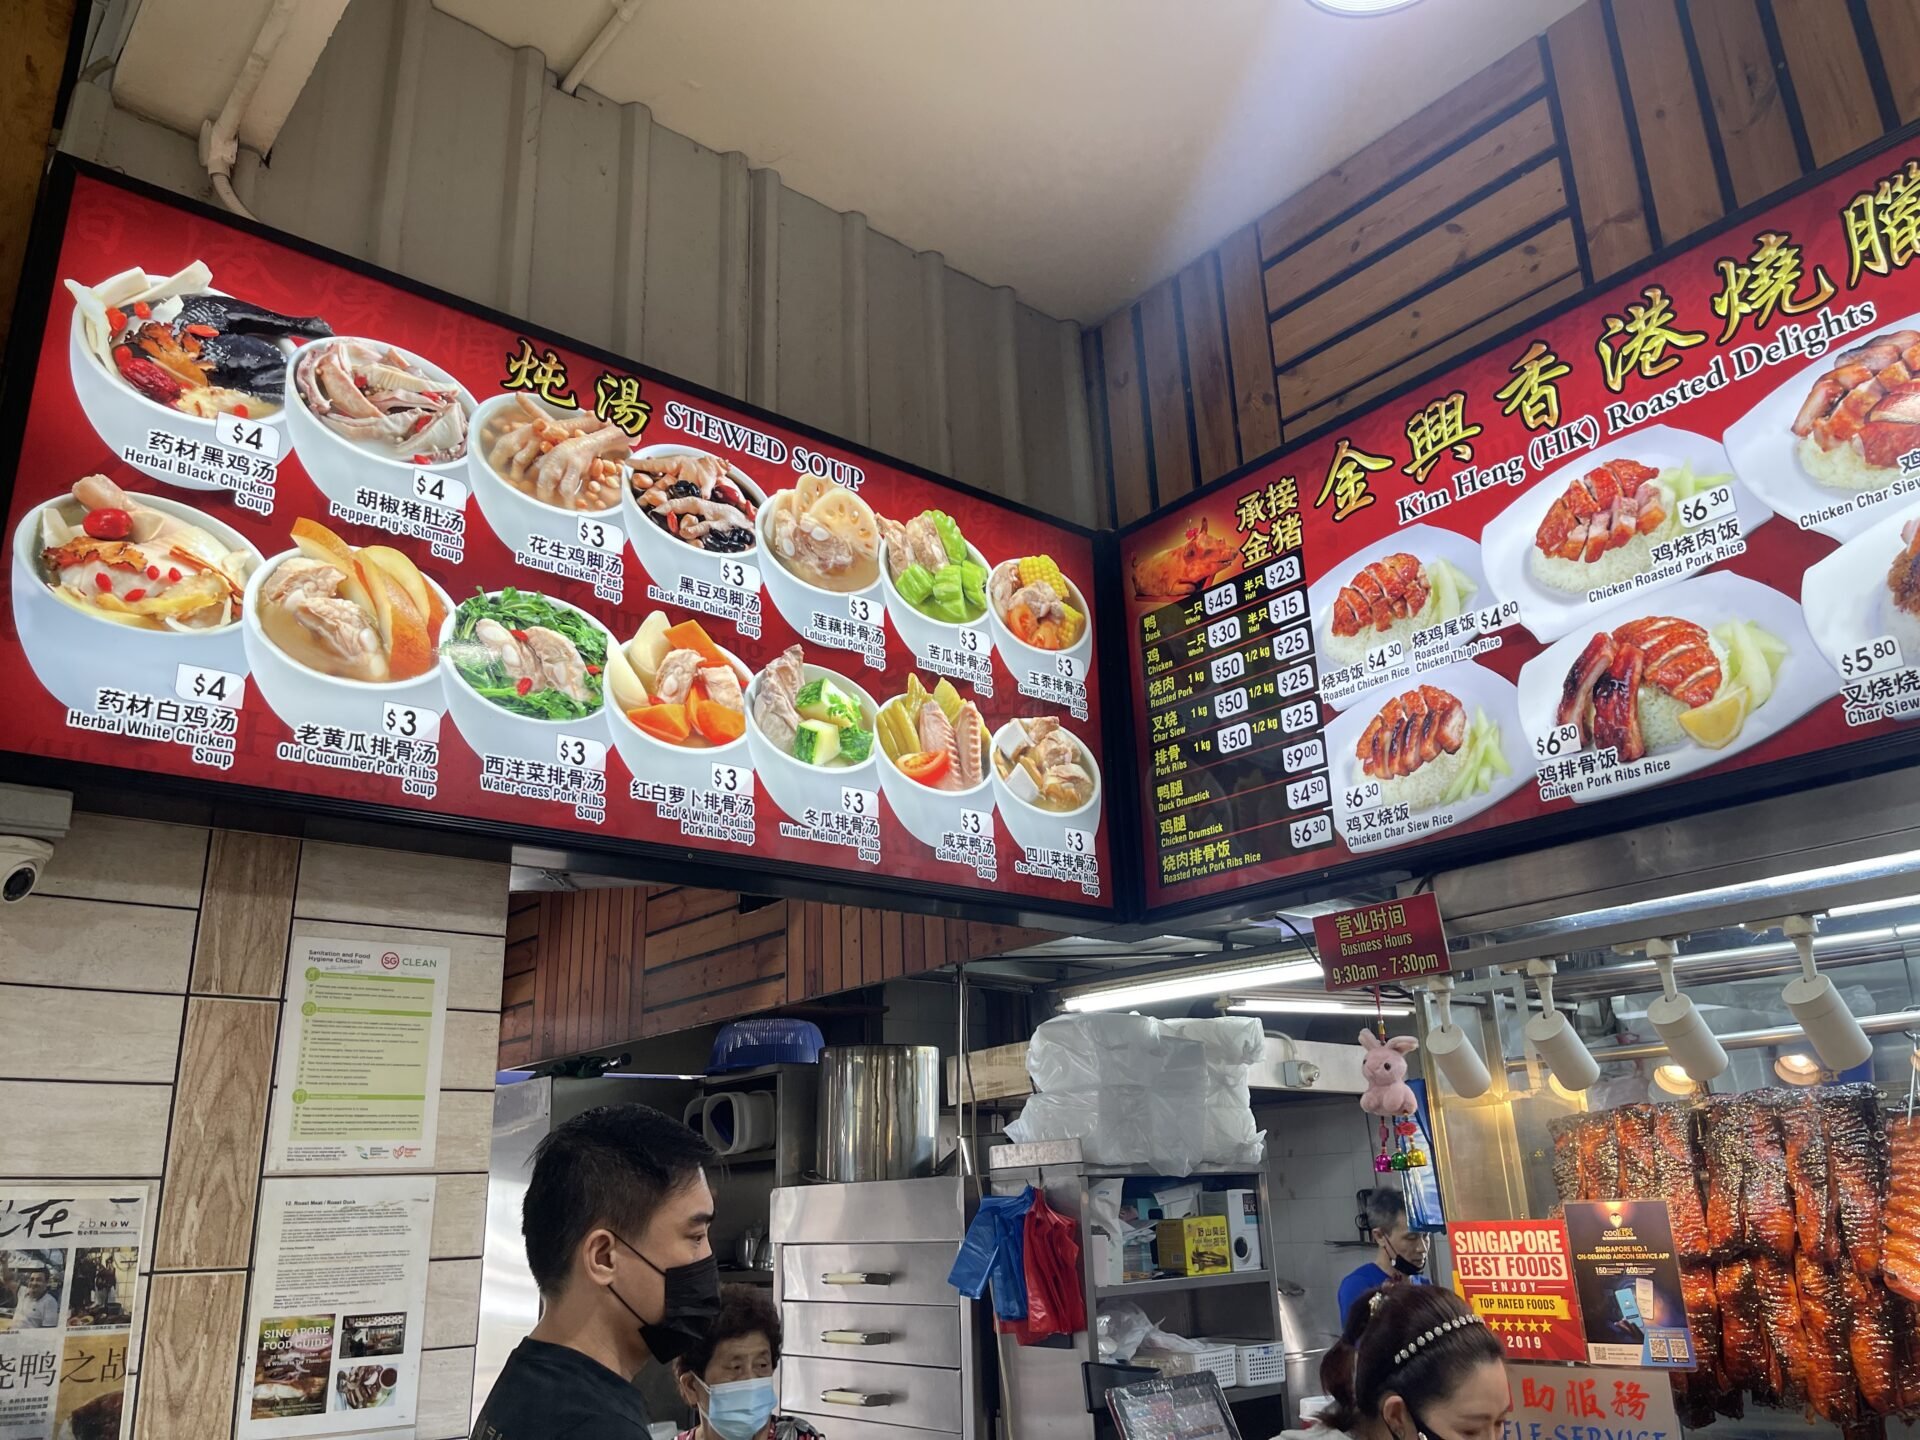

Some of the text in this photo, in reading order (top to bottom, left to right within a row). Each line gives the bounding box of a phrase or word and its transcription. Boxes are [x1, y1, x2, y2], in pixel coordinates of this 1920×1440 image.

[1397, 303, 1875, 524] Kim Heng (HK) Roasted Delights
[232, 423, 263, 450] $4
[665, 402, 786, 464] STEWED
[792, 447, 864, 490] SOUP
[149, 431, 275, 482] 药材黑鸡汤
[124, 448, 273, 497] Herbal Black Chicken
[417, 476, 445, 500] $4
[237, 493, 271, 513] Soup
[357, 488, 463, 533] 胡椒猪肚汤
[1236, 477, 1298, 531] 承接
[332, 503, 462, 547] Pepper Pig's Stomach
[580, 522, 605, 547] $3
[1241, 513, 1302, 568] 金猪
[1652, 519, 1740, 564] 鸡烧肉饭
[434, 543, 461, 562] Soup
[530, 536, 621, 575] 花生鸡脚汤
[517, 554, 622, 589] Peanut Chicken Feet
[723, 563, 744, 586] $3
[1244, 575, 1264, 591] 半只
[1270, 561, 1294, 584] $23
[1589, 543, 1744, 603] Chicken Roasted Pork Rice
[596, 585, 621, 602] Soup
[680, 576, 760, 612] 黑豆鸡脚汤
[1209, 589, 1233, 610] $45
[851, 600, 869, 620] $3
[1184, 602, 1204, 614] 一只
[1248, 608, 1268, 624] 半只
[1273, 597, 1297, 619] $15
[814, 613, 883, 645] 莲藕排骨汤
[962, 631, 976, 650] $3
[1145, 632, 1160, 642] Duck
[1187, 633, 1206, 646] 一只
[1212, 623, 1237, 644] $30
[1412, 614, 1475, 649] 烧鸡尾饭
[1277, 632, 1304, 655] $25
[1415, 641, 1449, 661] Roasted
[1416, 638, 1500, 672] Chicken Thigh Rice
[928, 644, 991, 673] 苦瓜排骨汤
[1147, 648, 1160, 664] 鸡
[1148, 660, 1172, 675] Chicken
[1215, 658, 1239, 679] $50
[1321, 664, 1364, 690] 烧鸡饭
[193, 674, 226, 701] $4
[1149, 676, 1174, 698] 烧肉
[1282, 670, 1309, 691] $25
[1323, 667, 1409, 701] Roasted Chicken Rice
[1150, 687, 1193, 708] Roasted Pork
[1218, 692, 1243, 713] $50
[97, 689, 235, 732] 药材白鸡汤
[1152, 711, 1178, 733] 叉烧
[1286, 707, 1313, 728] $25
[69, 711, 233, 749] Herbal White Chicken
[386, 709, 417, 736] $3
[297, 724, 437, 765] 老黄瓜排骨汤
[1153, 726, 1185, 743] Char Siew
[1222, 728, 1247, 749] $50
[195, 748, 231, 767] Soup
[279, 745, 435, 780] Old Cucumber Pork Ribs
[560, 741, 585, 766] $3
[1155, 744, 1180, 766] 排骨
[484, 755, 604, 792] 西洋菜排骨汤
[1156, 761, 1187, 776] Pork Ribs
[1539, 748, 1617, 784] 鸡排骨饭
[404, 779, 435, 797] Soup
[714, 768, 737, 790] $3
[1157, 780, 1184, 801] 鸭腿
[631, 781, 753, 816] 红白萝卜排骨汤
[845, 792, 864, 813] $3
[1159, 790, 1209, 812] Duck Drumstick
[805, 809, 878, 835] 冬瓜排骨汤
[963, 814, 980, 833] $3
[1160, 815, 1186, 835] 鸡腿
[1346, 803, 1409, 833] 鸡叉烧饭
[943, 833, 994, 855] 咸菜鸭汤
[1067, 832, 1083, 851] $3
[1161, 823, 1223, 847] Chicken Drumstick
[1027, 849, 1097, 872] 四川菜排骨汤
[1163, 840, 1230, 872] 烧肉排骨饭
[1335, 905, 1406, 939] 营业时间
[1341, 933, 1413, 956] Business Hours
[384, 957, 436, 967] SG CLEAN
[1333, 964, 1379, 985] 9:30am
[1390, 954, 1438, 975] 7:30pm
[1455, 1230, 1562, 1254] SINGAPORE
[1461, 1256, 1562, 1277] BEST FOODS
[1492, 1281, 1536, 1293] ENJOY
[1480, 1299, 1555, 1310] TOP RATED FOODS
[263, 1338, 329, 1350] FOOD GUIDE
[264, 1327, 330, 1339] SINGAPORE
[1507, 1336, 1542, 1349] 2019
[1508, 1377, 1649, 1421] 助服務
